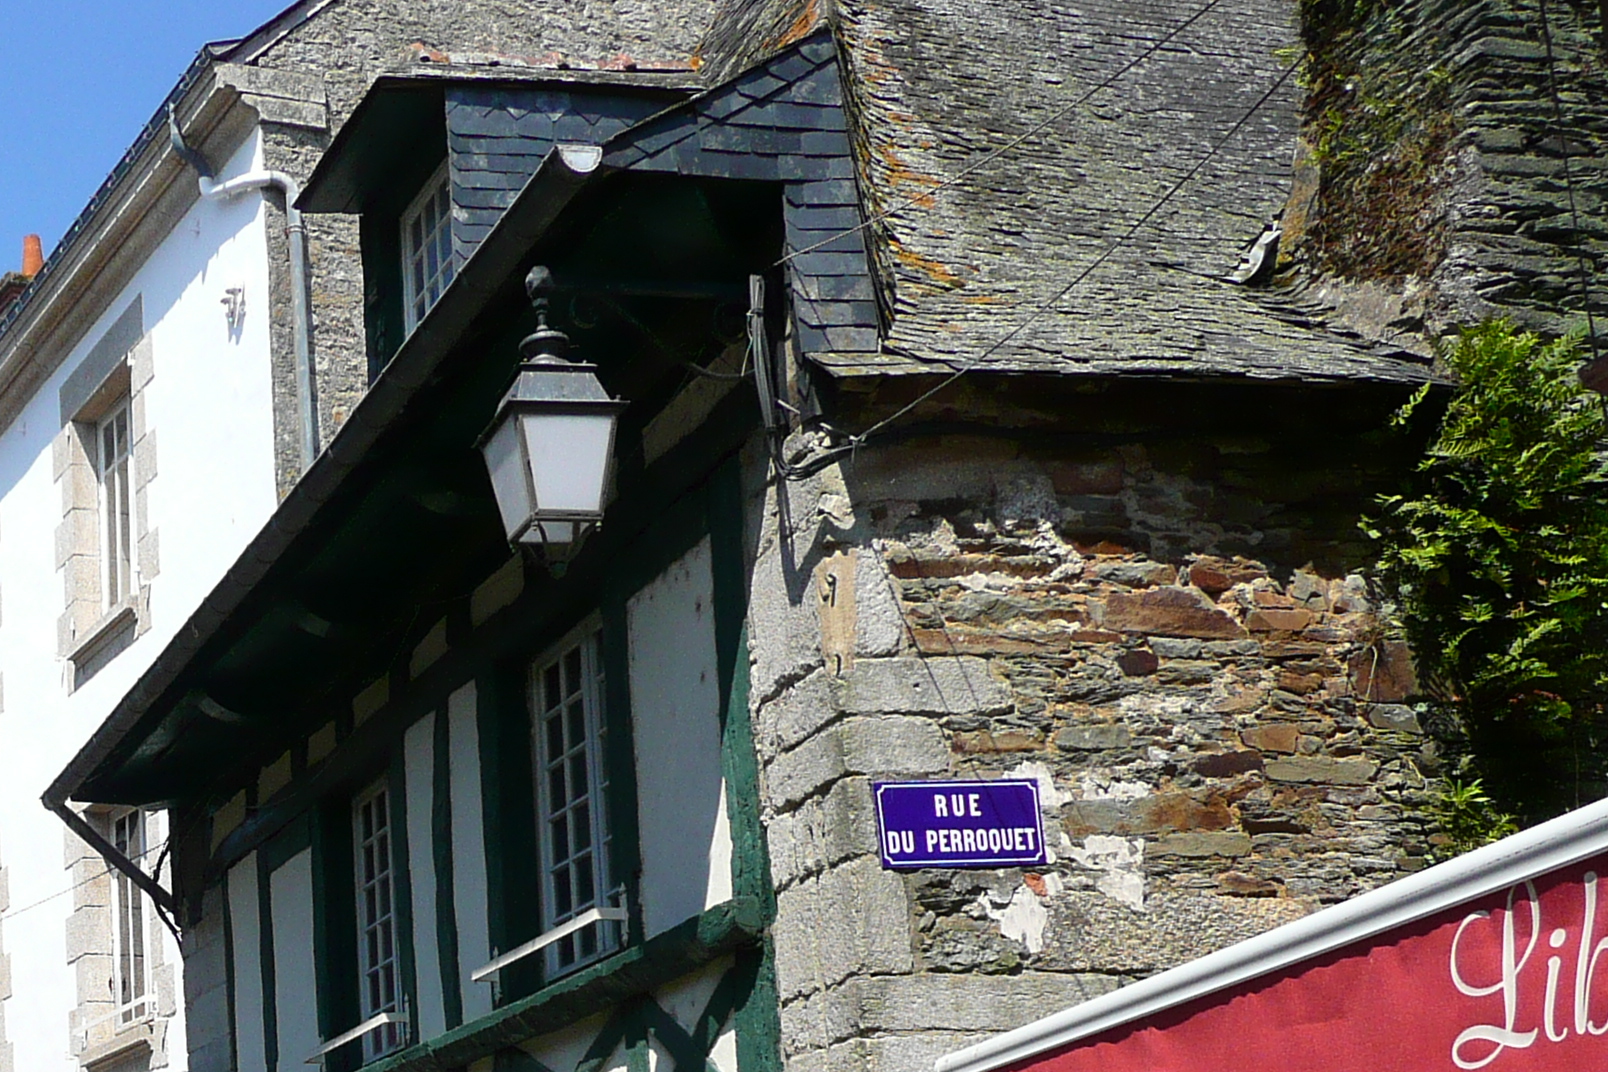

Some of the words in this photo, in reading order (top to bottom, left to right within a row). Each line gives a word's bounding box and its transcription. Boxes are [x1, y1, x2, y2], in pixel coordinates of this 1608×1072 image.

[934, 794, 982, 818] RUE
[887, 829, 915, 854] DU
[926, 827, 1036, 853] PERROQUET
